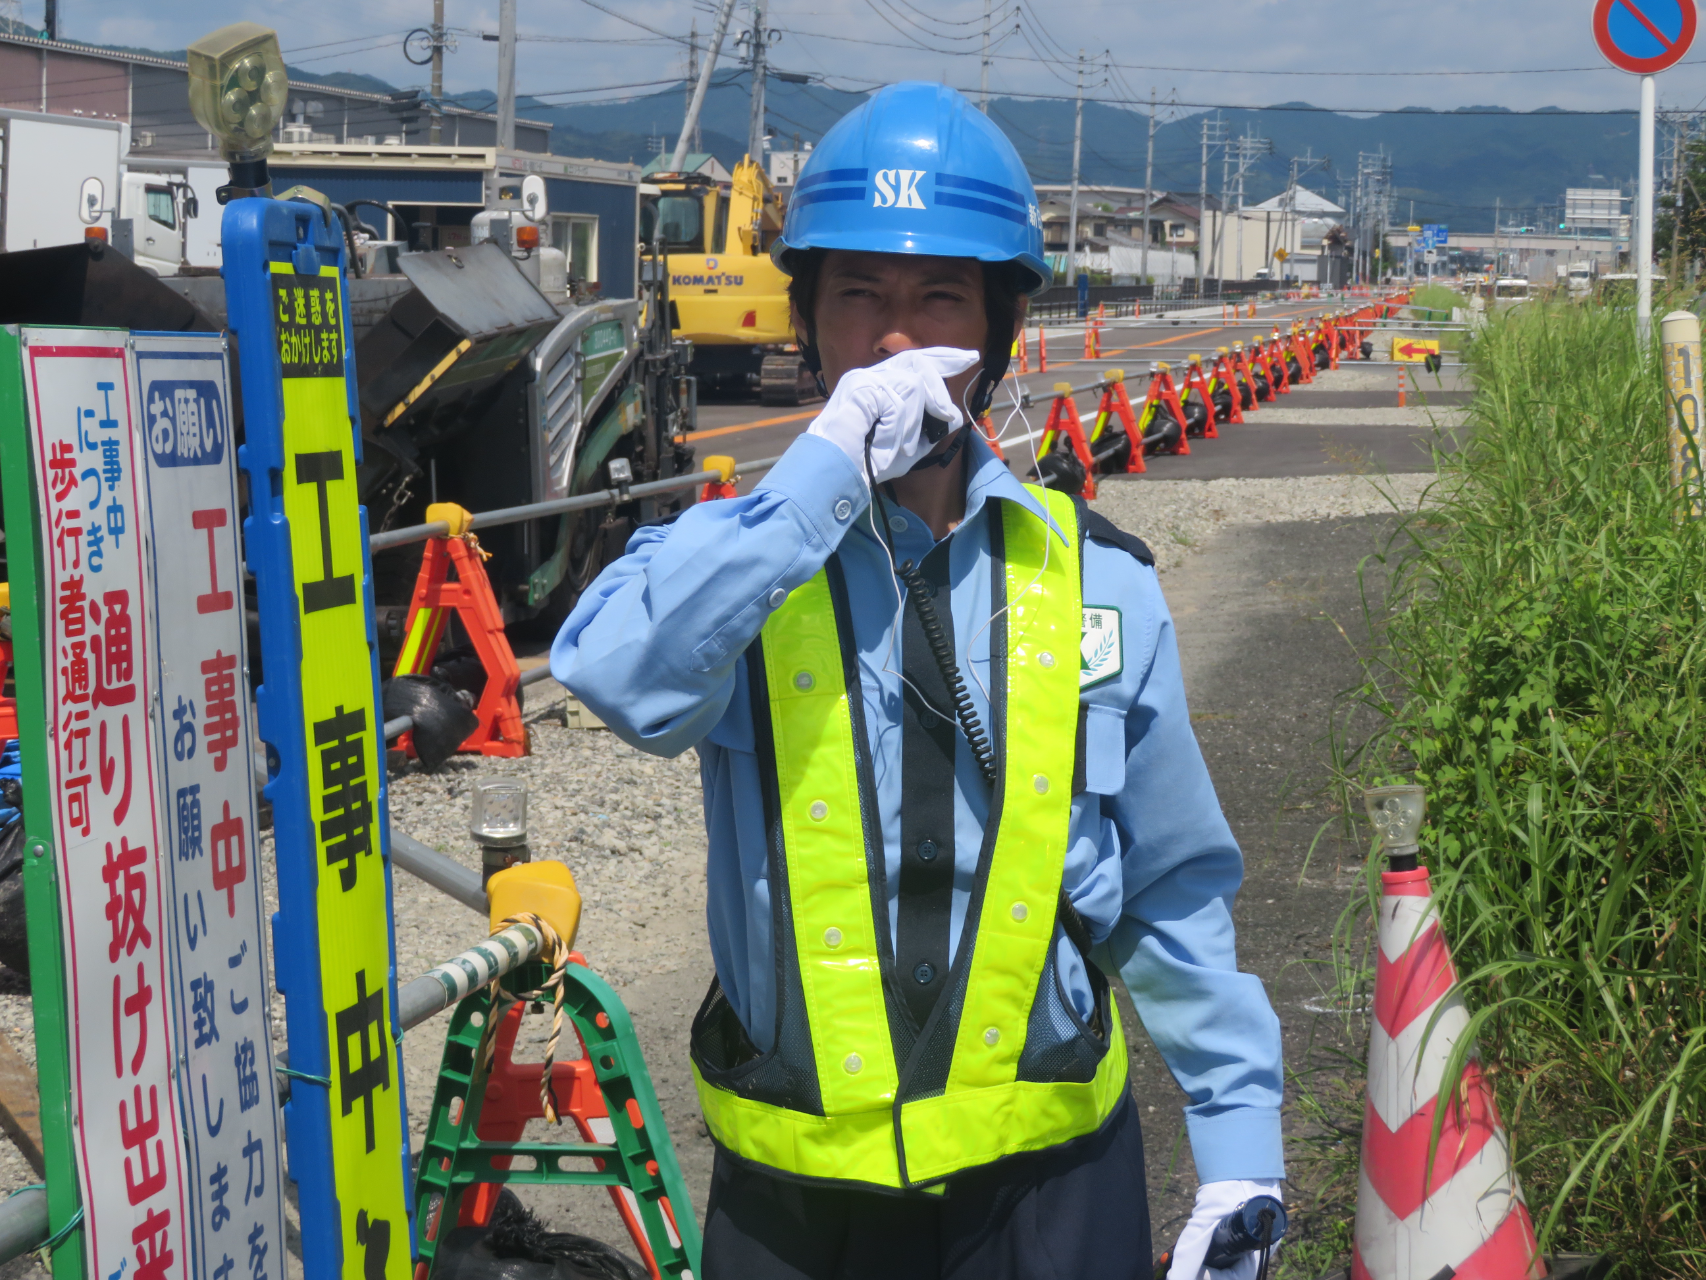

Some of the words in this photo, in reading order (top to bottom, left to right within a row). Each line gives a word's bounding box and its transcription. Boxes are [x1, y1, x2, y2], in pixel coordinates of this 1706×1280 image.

[873, 169, 927, 210] SK
[279, 287, 336, 326] ご迷惑を
[672, 272, 744, 286] KOMATSU
[280, 327, 338, 364] おかけします
[96, 381, 126, 549] 工事中
[150, 388, 222, 459] お願い
[77, 406, 105, 573] につき
[192, 507, 247, 918] 工事中
[294, 449, 391, 1155] 工事中
[228, 939, 270, 1280] ご協力を
